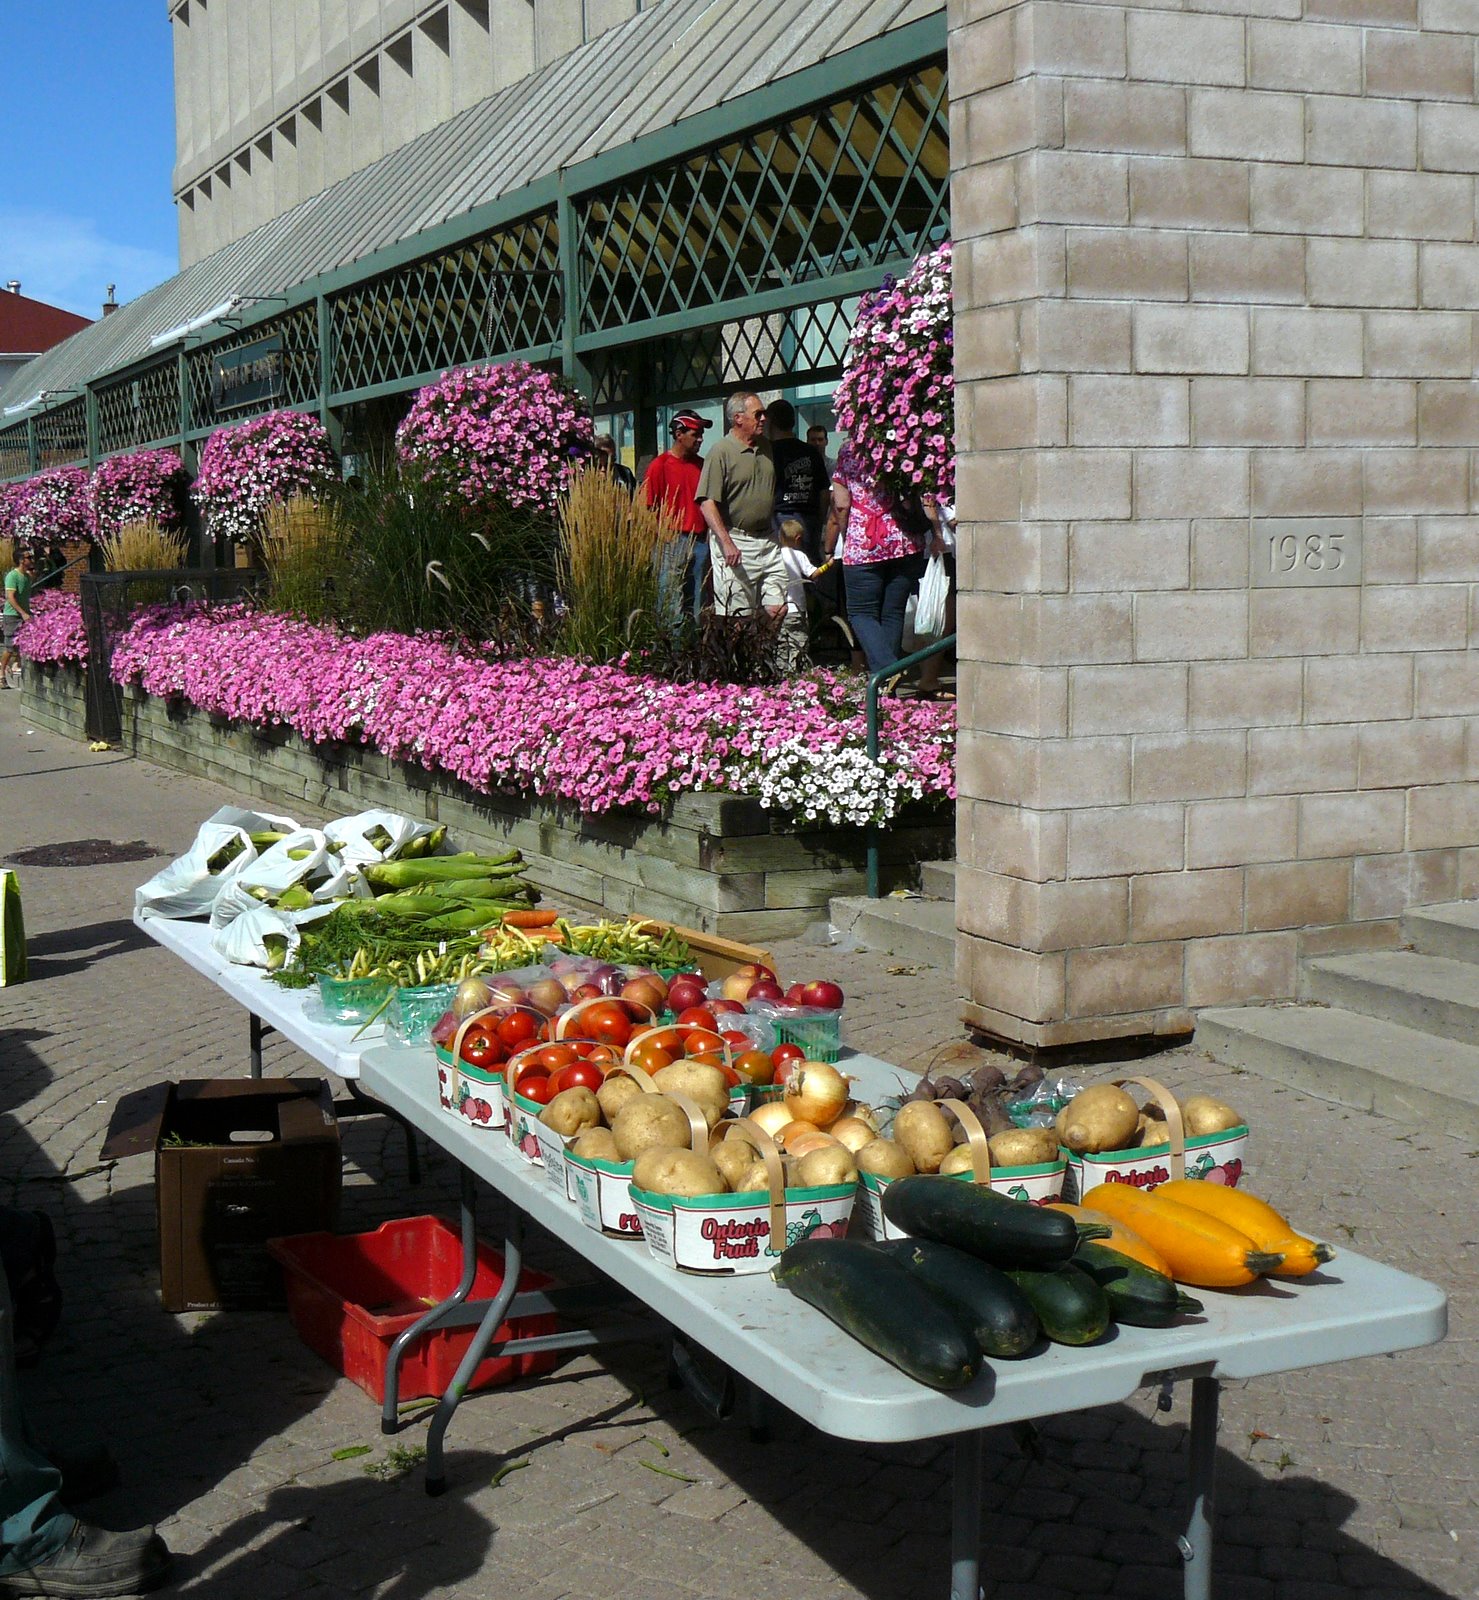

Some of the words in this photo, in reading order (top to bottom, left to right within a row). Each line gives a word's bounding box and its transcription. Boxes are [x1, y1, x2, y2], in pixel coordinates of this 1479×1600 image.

[1269, 534, 1345, 573] 1985
[701, 1217, 771, 1241] Ontario
[713, 1238, 760, 1260] Fruit
